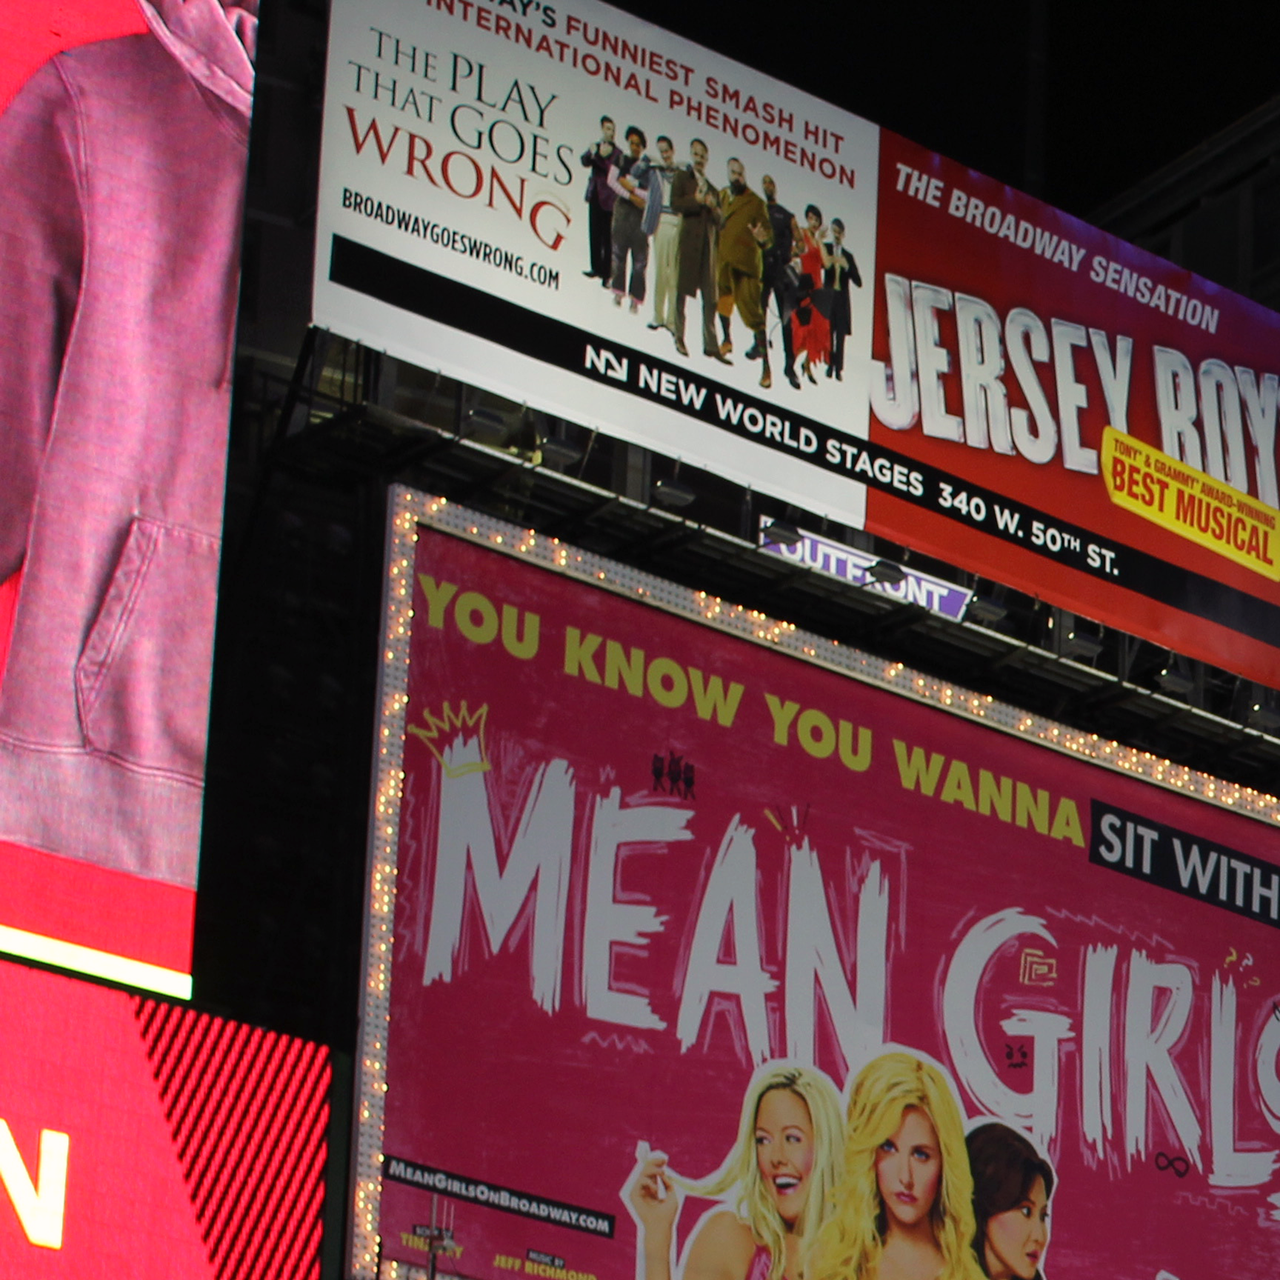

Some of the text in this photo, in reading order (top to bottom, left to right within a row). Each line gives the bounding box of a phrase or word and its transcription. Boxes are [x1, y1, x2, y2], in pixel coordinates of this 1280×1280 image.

[348, 59, 574, 187] THAT GOES
[369, 26, 559, 130] THE PLAY
[565, 15, 845, 155] FUNNIEST SMASH HIT
[669, 87, 856, 189] PHENOMENON
[342, 187, 560, 291] BROADWAYGOESWRONG.COM
[344, 105, 572, 253] WRONG
[895, 163, 1220, 334] THE BROADWAY SENSATION
[871, 274, 1133, 476] JERSEY
[638, 363, 708, 411] NEW
[715, 393, 818, 454] WORLD
[826, 439, 924, 497] STAGES
[937, 482, 986, 522] 340
[994, 503, 1025, 541] W.
[1086, 544, 1120, 576] ST.
[1112, 456, 1273, 566] BEST MUSICAL
[417, 573, 541, 660] YOU
[564, 626, 744, 728] KNOW
[764, 692, 873, 773] YOU
[892, 738, 1086, 849] WANNA
[1099, 812, 1159, 875] SIT
[1174, 837, 1280, 920] WITH
[420, 733, 889, 1082] MEAN
